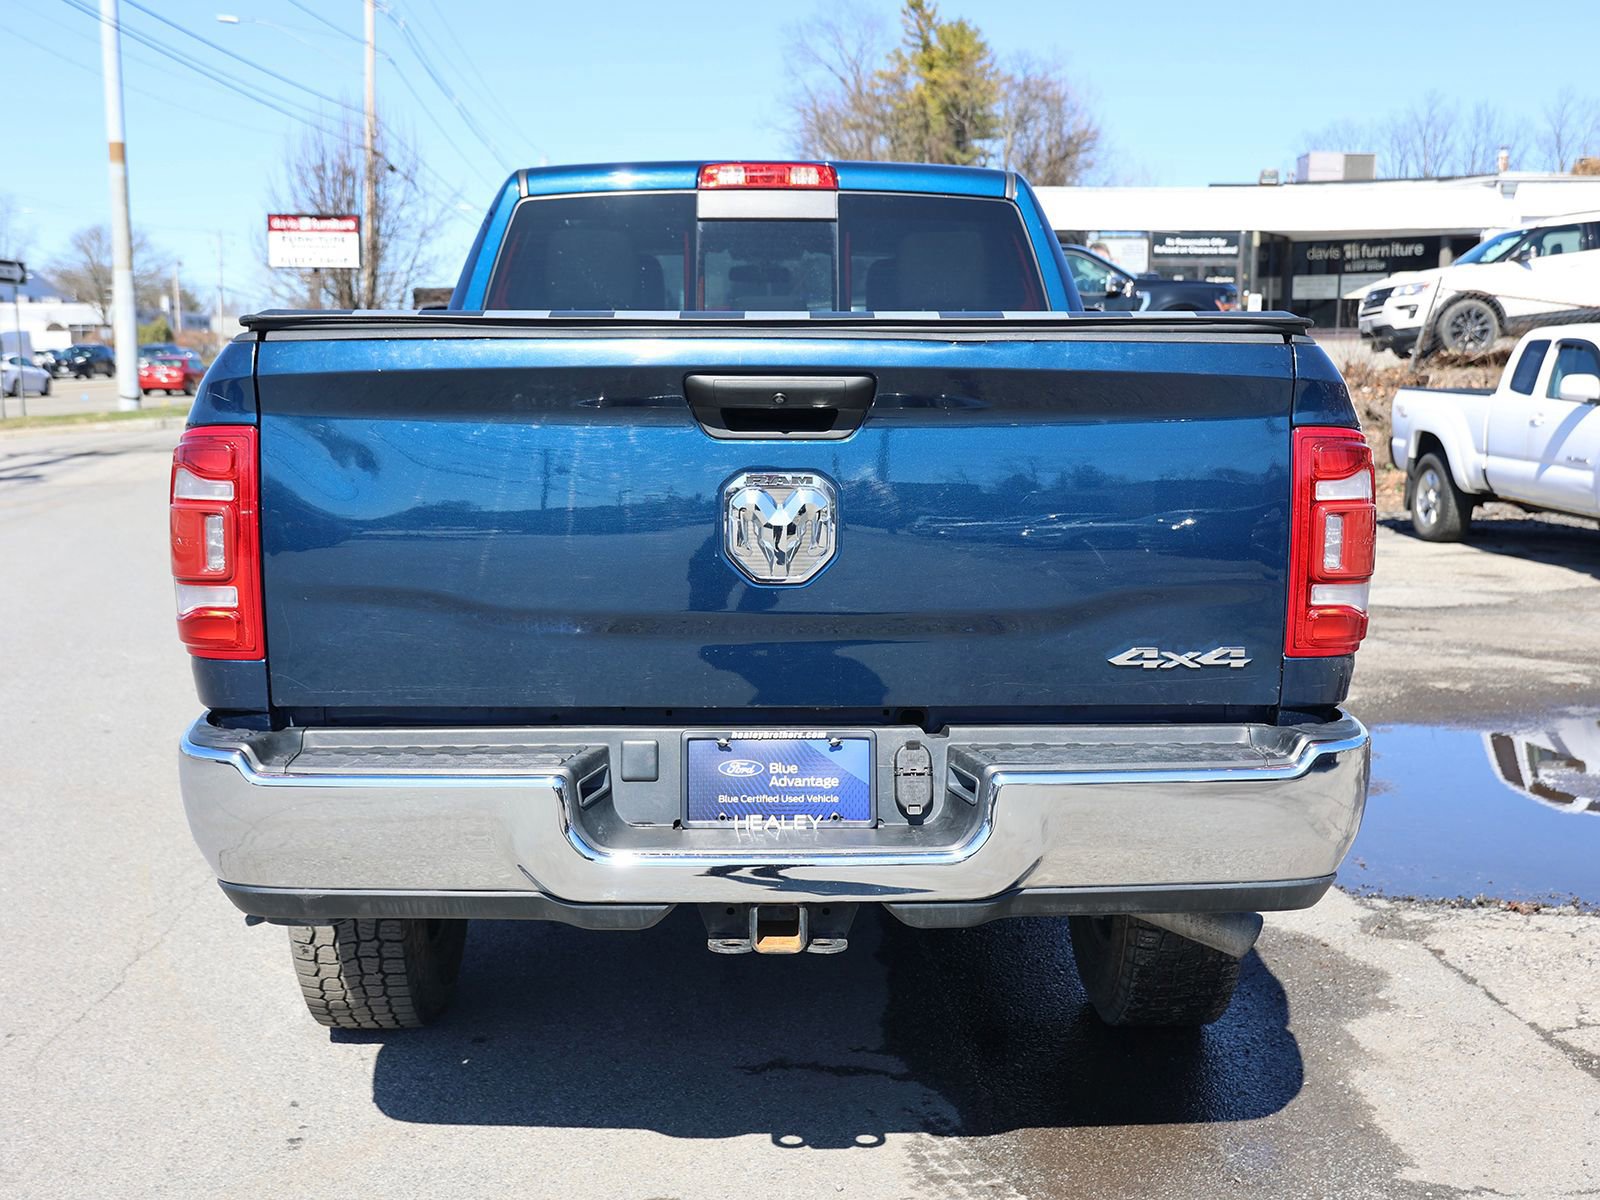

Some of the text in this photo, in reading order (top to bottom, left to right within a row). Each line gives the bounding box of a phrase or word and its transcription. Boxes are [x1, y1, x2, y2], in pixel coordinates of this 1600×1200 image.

[1306, 241, 1425, 261] davis furniture
[745, 474, 814, 486] RAM
[1107, 646, 1253, 669] 4x4
[726, 761, 756, 775] Ford
[769, 762, 798, 774] Blue
[769, 775, 840, 788] Advantage
[718, 794, 839, 803] Blue Certified Used Vehicle
[734, 814, 823, 830] HEALEY
